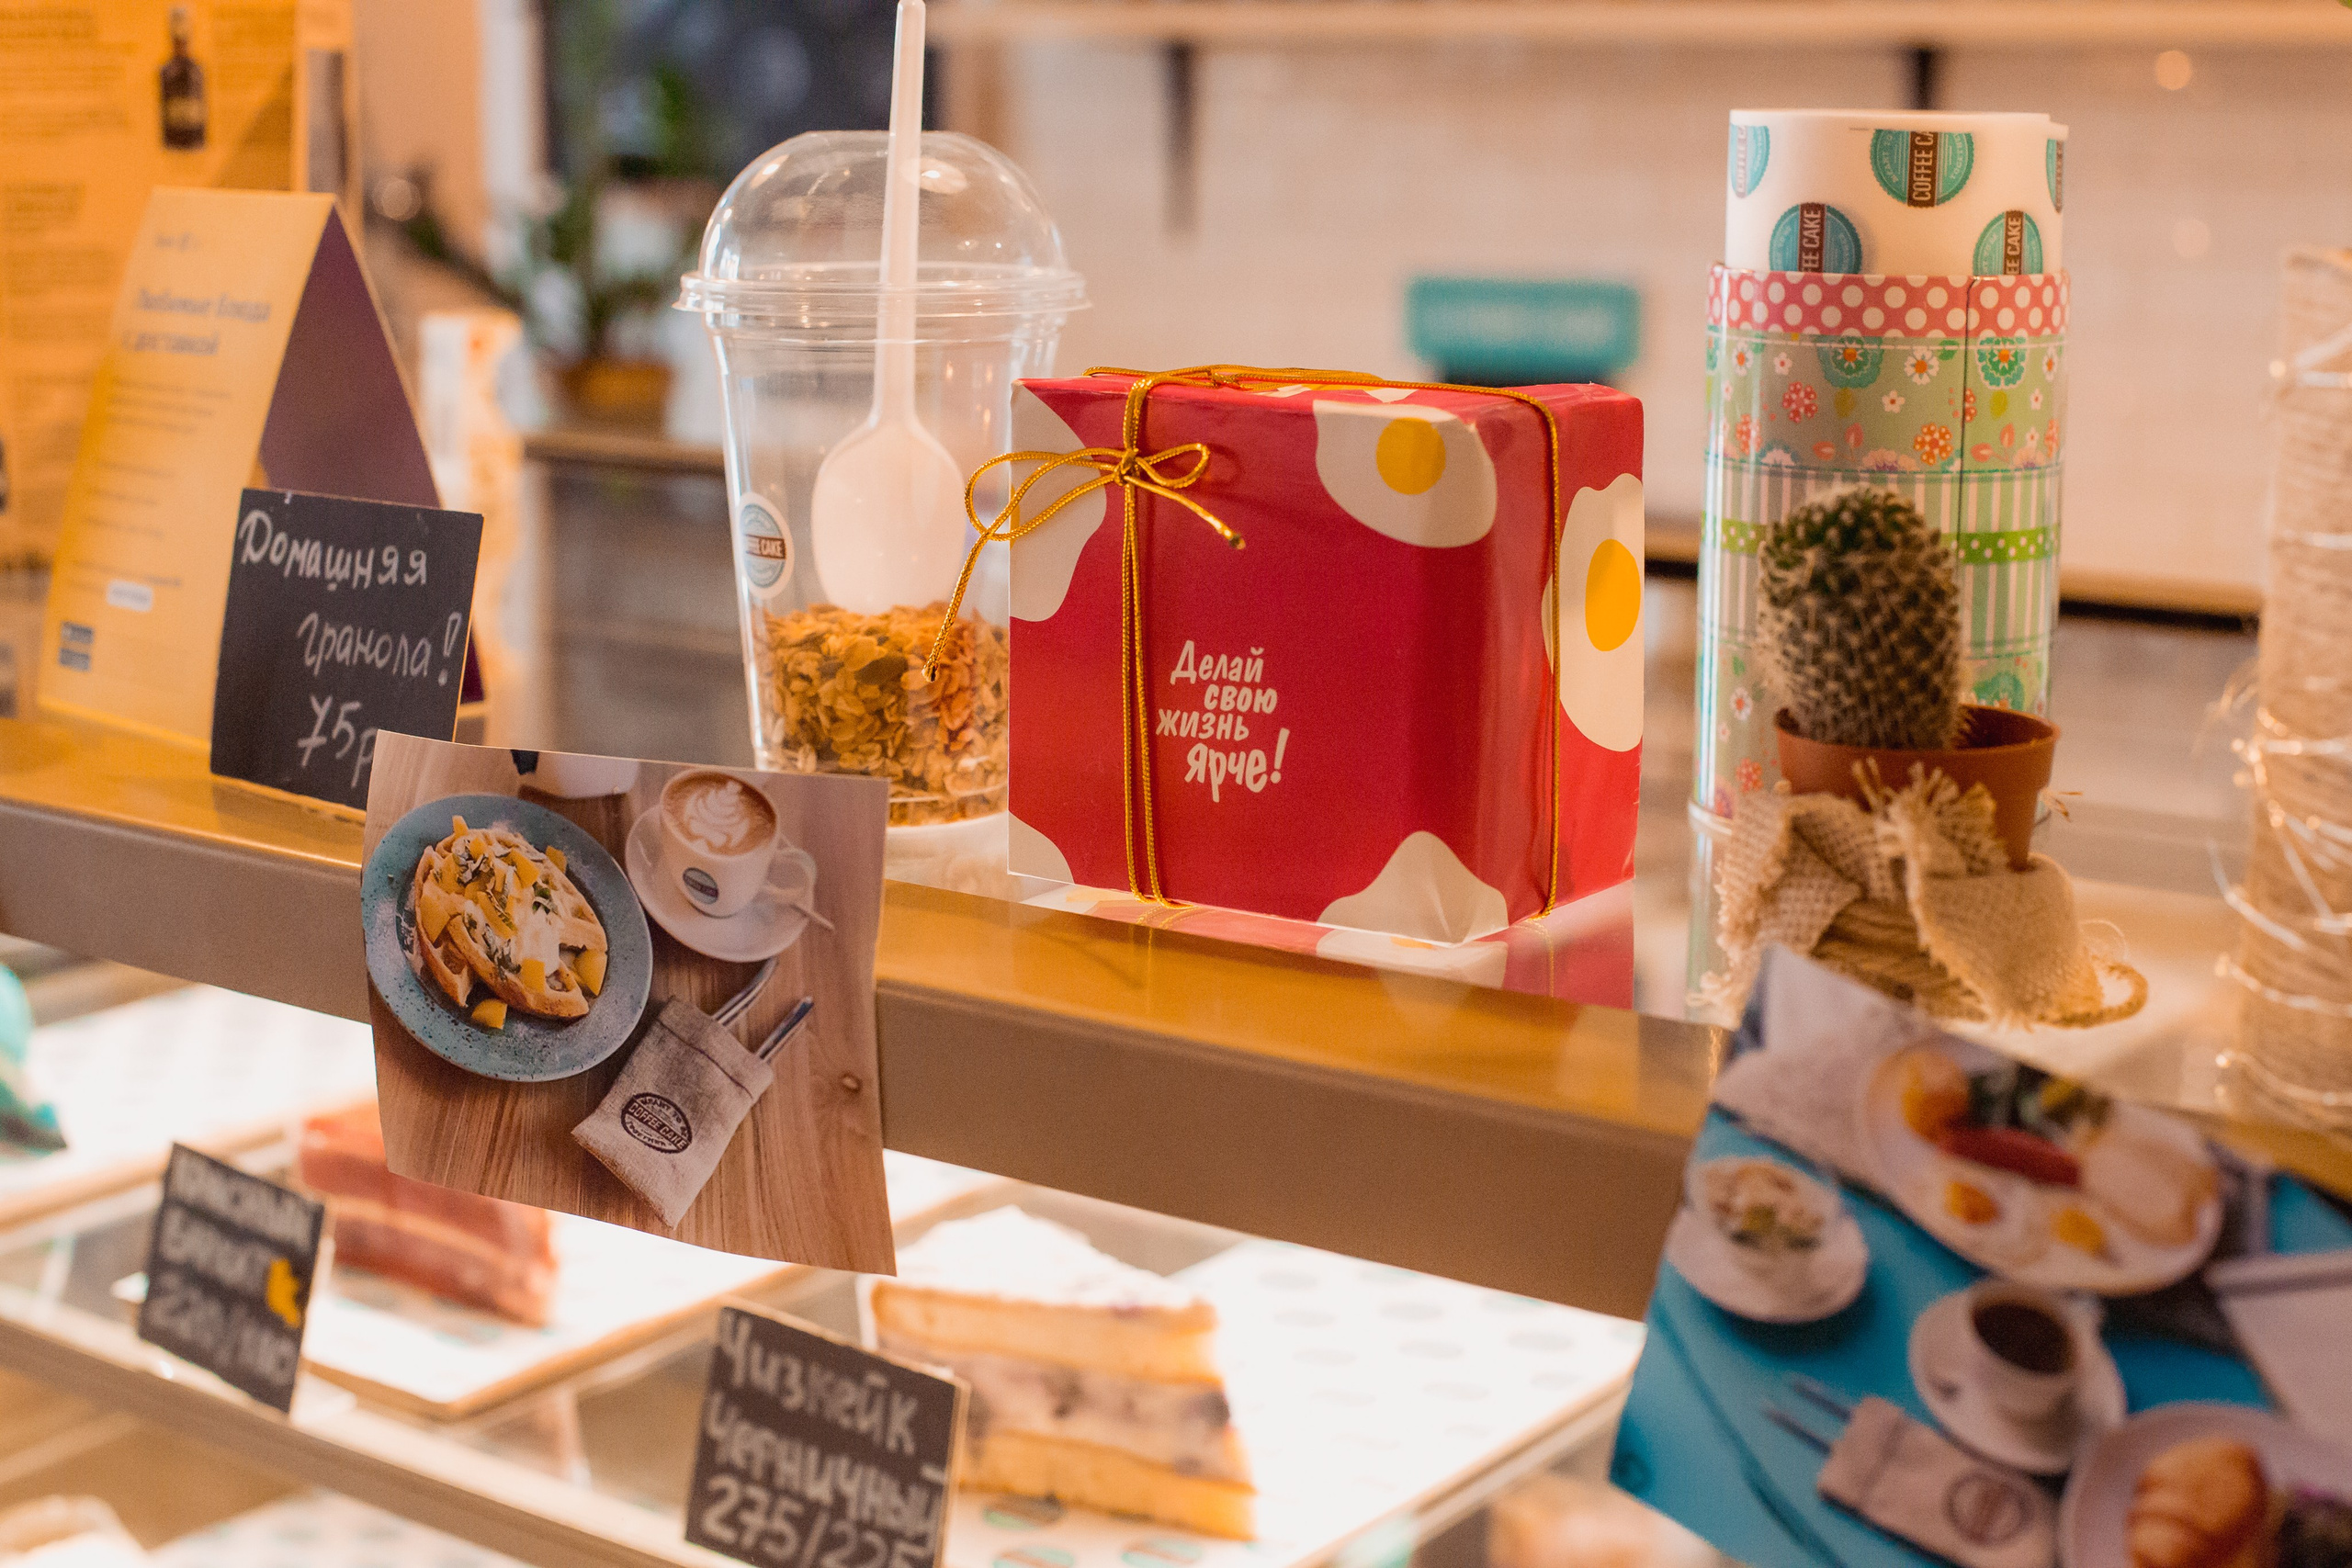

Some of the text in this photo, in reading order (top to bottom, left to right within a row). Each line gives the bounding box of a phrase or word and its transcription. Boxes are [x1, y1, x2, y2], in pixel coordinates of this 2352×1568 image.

[1912, 150, 1933, 201] COFFEE
[1803, 210, 1821, 248] CAKE
[2007, 217, 2021, 255] CAKE
[238, 509, 427, 590] Домашняя
[1170, 639, 1265, 685] Делай
[1204, 683, 1278, 714] свою
[1155, 708, 1250, 741] жизнь
[628, 1102, 687, 1149] COFFEE CAKE
